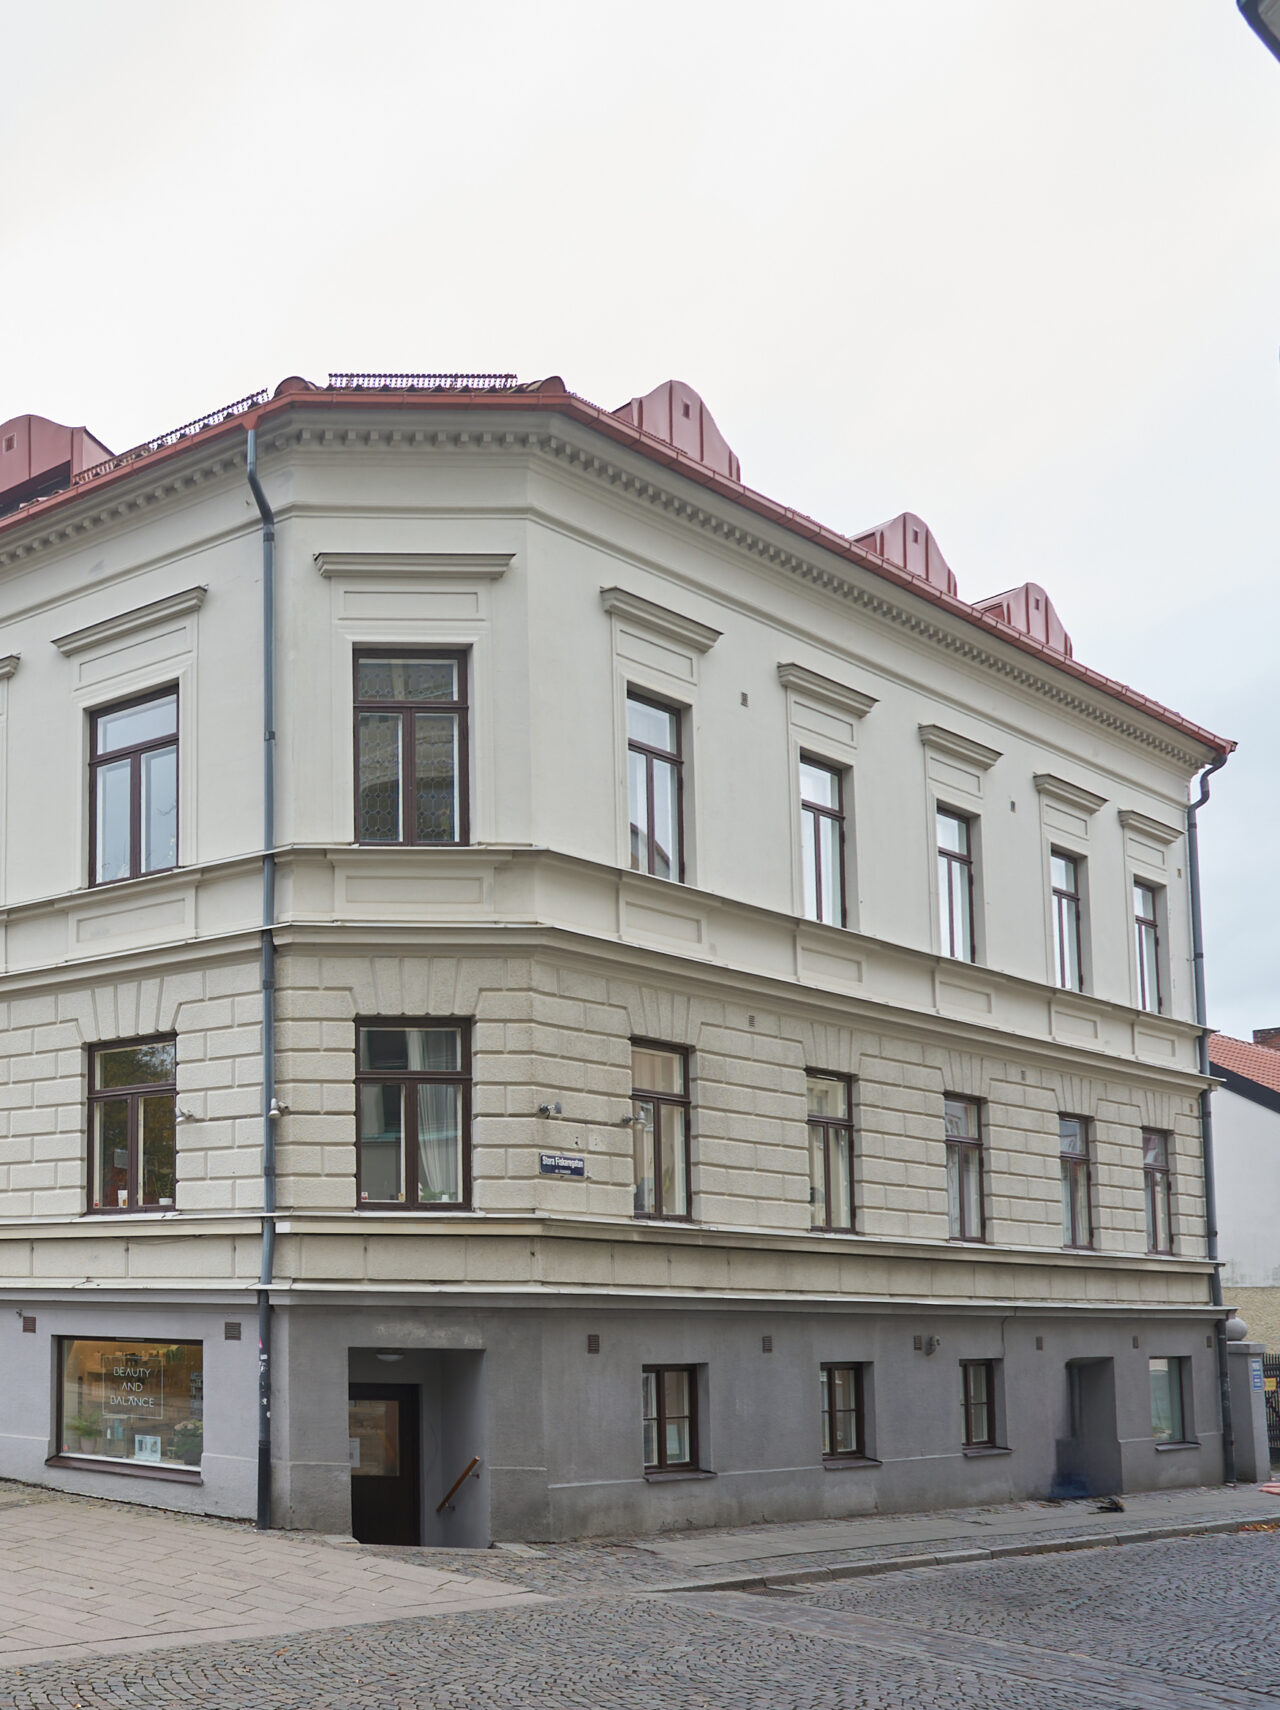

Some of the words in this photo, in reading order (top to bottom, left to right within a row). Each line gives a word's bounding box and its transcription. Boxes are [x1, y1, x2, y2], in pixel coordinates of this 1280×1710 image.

[113, 1366, 151, 1378] BEAUTY
[121, 1381, 143, 1392] AND
[110, 1395, 155, 1408] BALANCE
